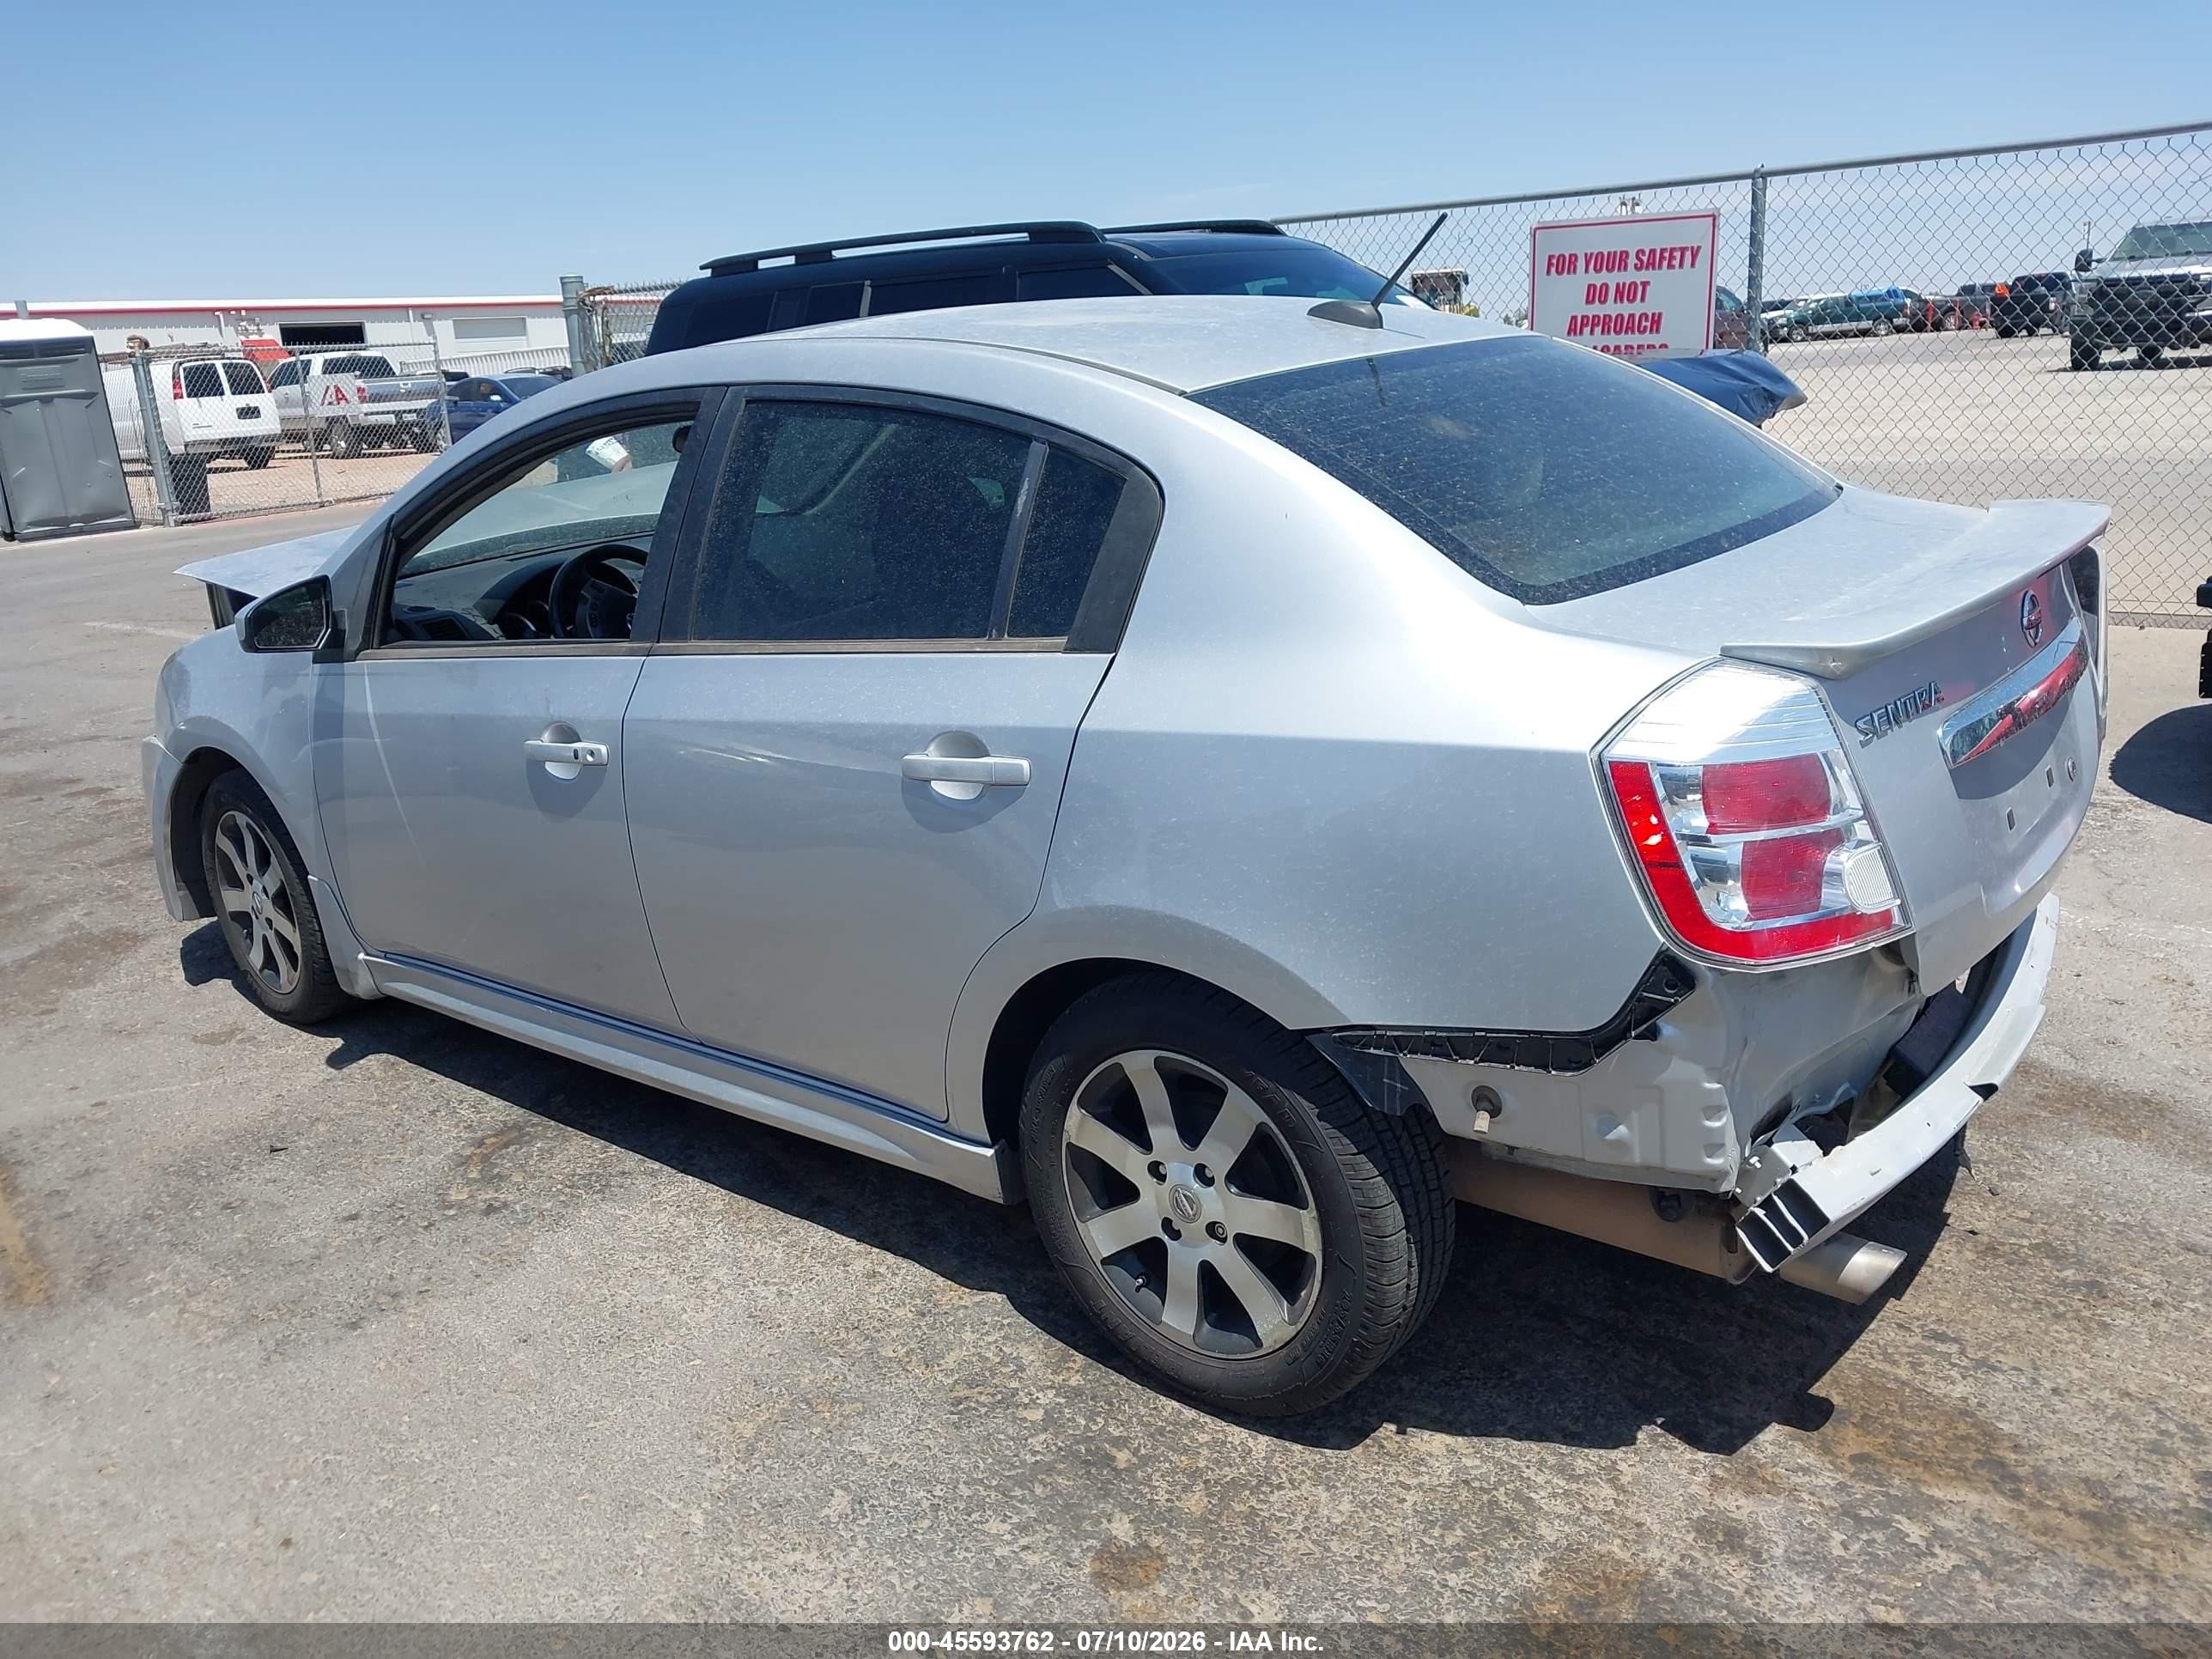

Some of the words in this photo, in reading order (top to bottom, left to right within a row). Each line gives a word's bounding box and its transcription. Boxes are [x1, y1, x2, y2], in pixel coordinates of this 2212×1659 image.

[1546, 253, 1578, 276] FOR
[1583, 248, 1630, 275] YOUR
[1634, 246, 1701, 270] SAFETY
[1585, 283, 1609, 305] DO
[1613, 280, 1650, 304] NOT
[1567, 312, 1662, 337] APPROACH
[1854, 680, 1945, 749] SENTRA
